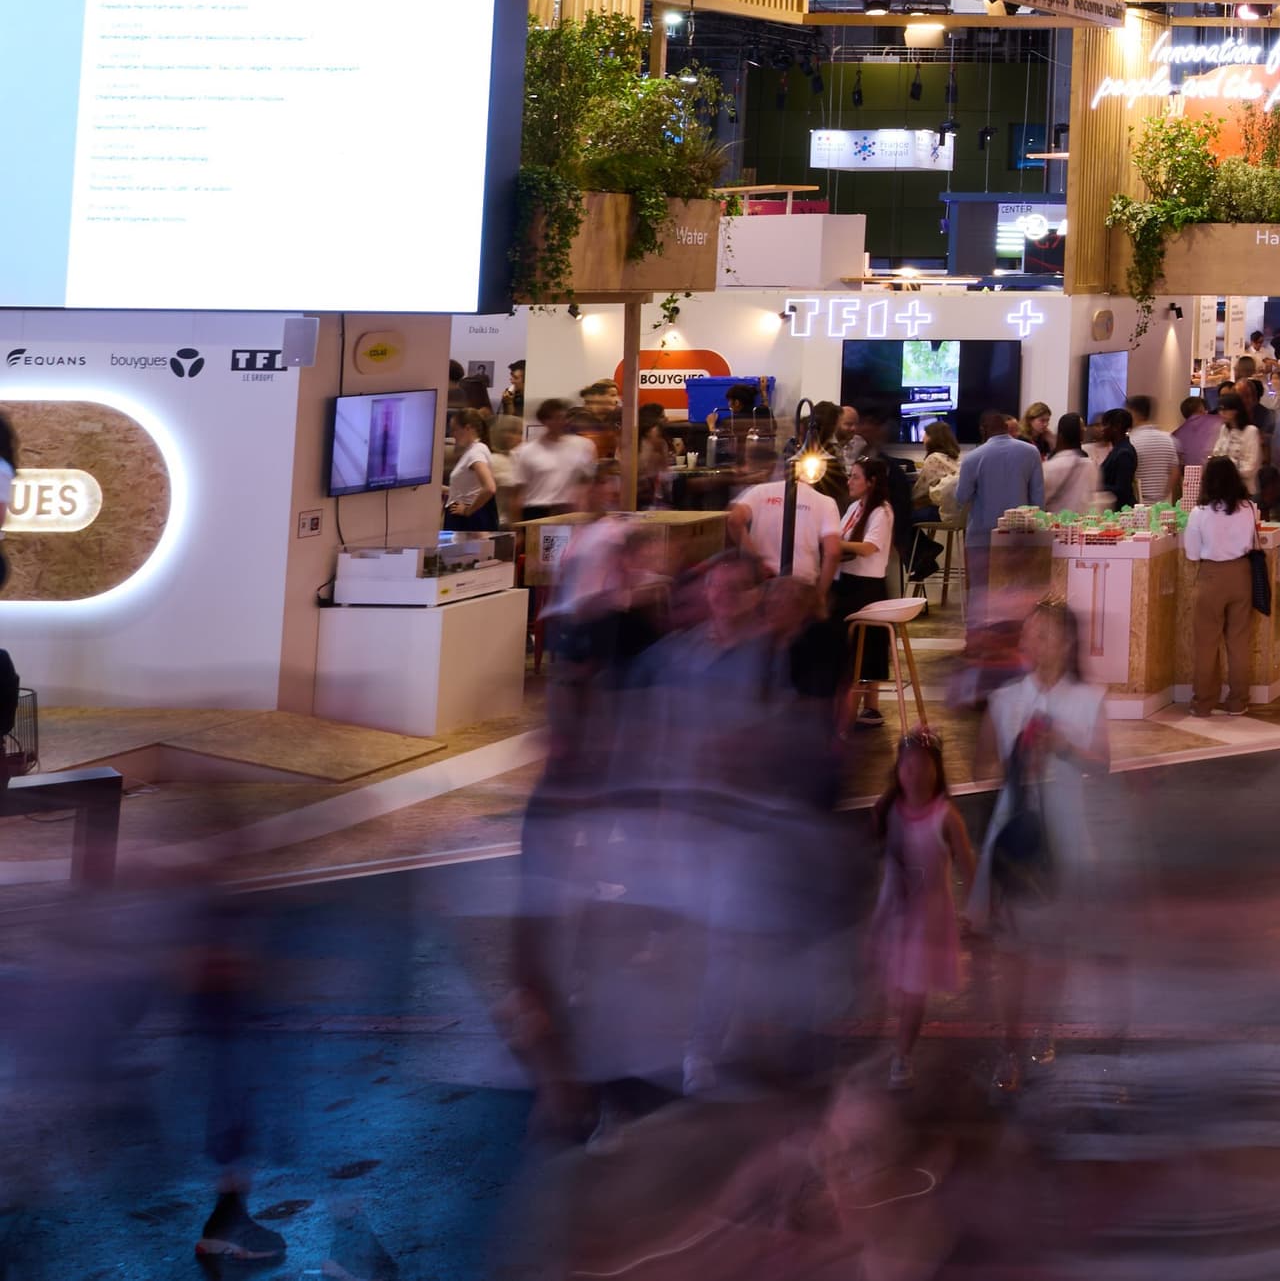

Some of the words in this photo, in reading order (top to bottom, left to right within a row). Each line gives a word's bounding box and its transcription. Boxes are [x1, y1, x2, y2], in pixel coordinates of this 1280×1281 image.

[1149, 31, 1262, 65] Innovation
[1091, 65, 1174, 110] people
[1180, 68, 1224, 98] and
[1222, 70, 1264, 100] the
[1000, 205, 1033, 214] CENTER
[676, 227, 708, 246] Water
[24, 356, 87, 366] EQUANS
[110, 354, 168, 369] bouygues
